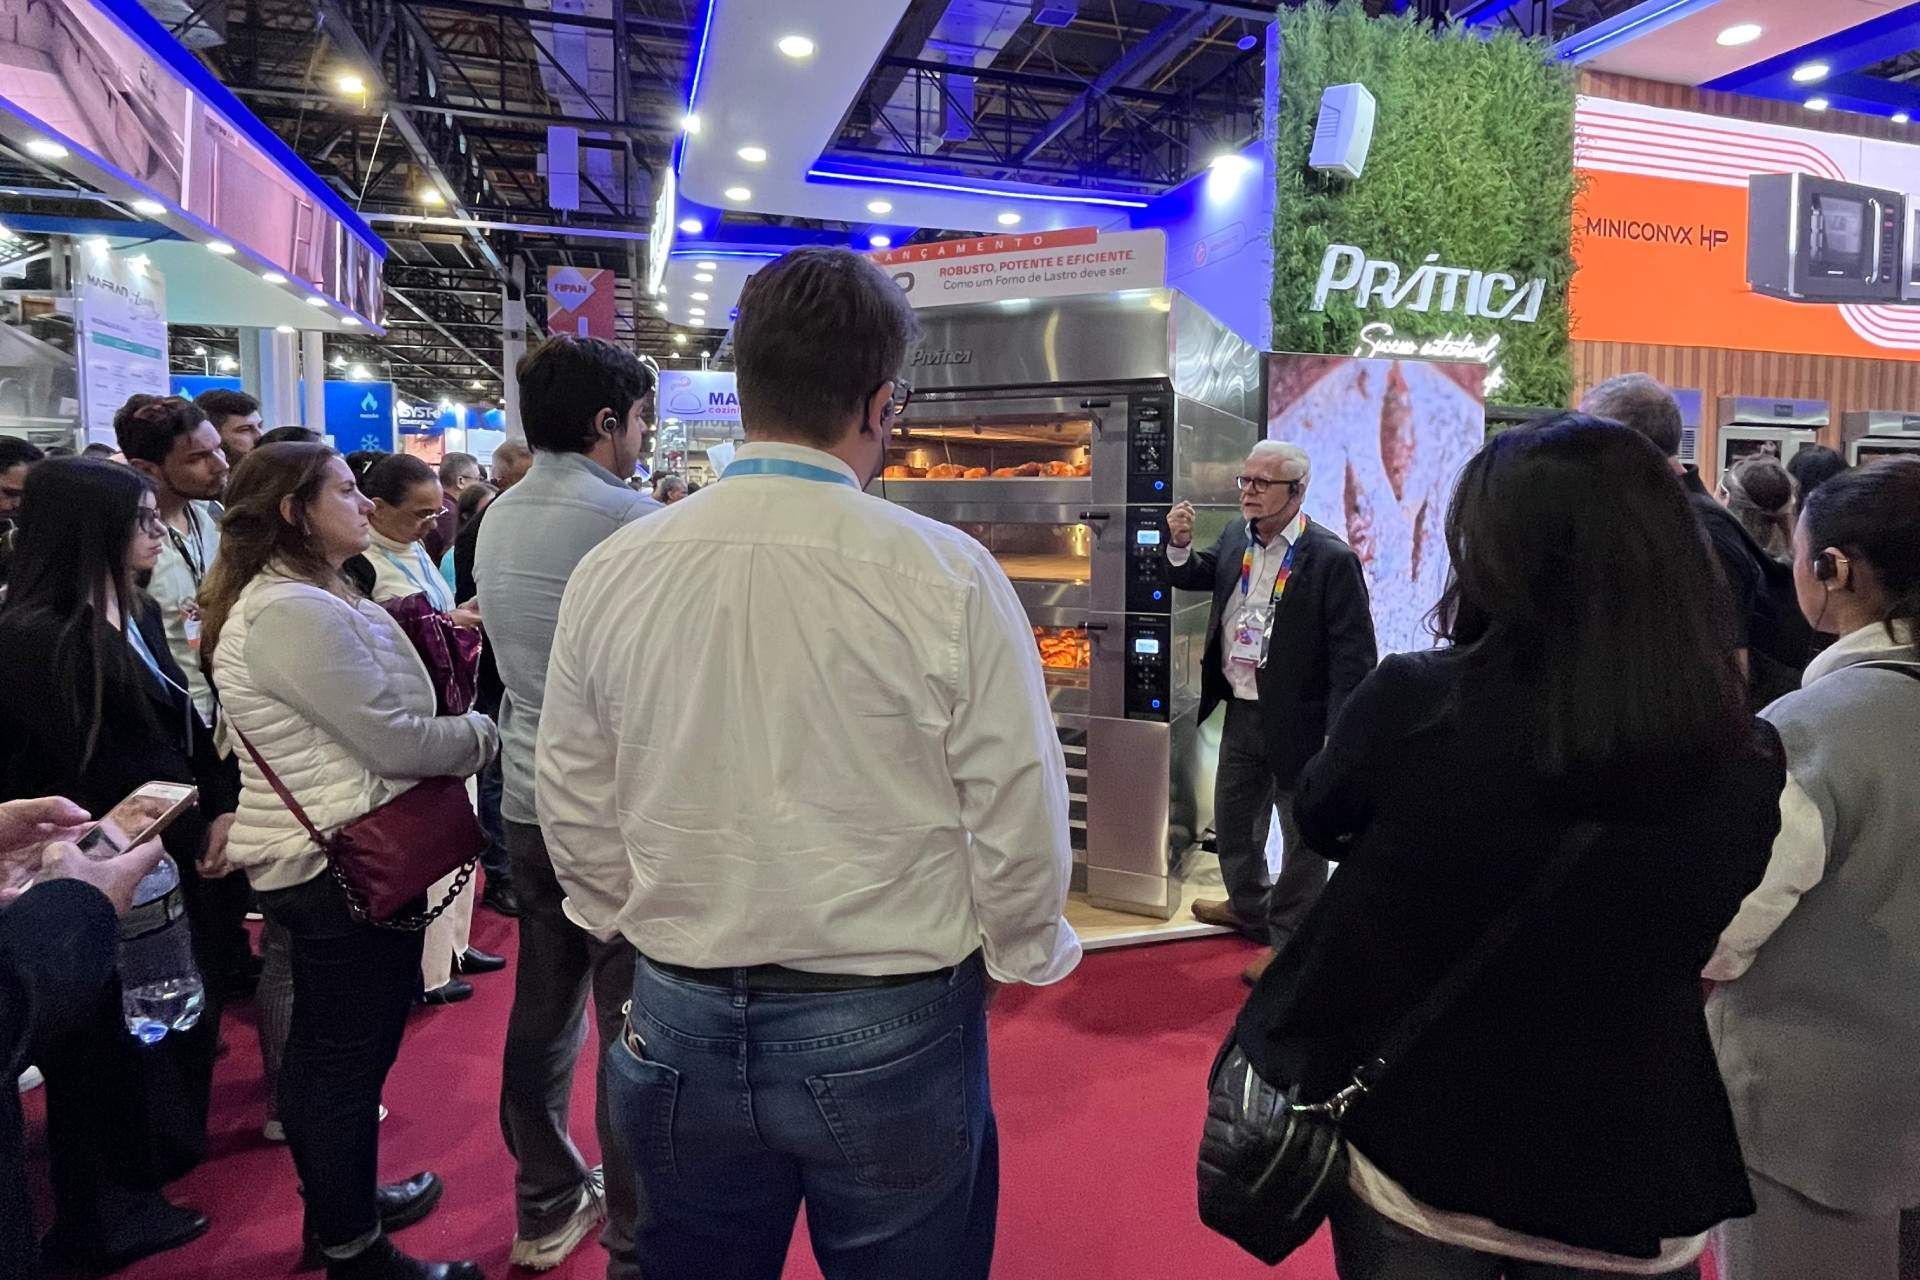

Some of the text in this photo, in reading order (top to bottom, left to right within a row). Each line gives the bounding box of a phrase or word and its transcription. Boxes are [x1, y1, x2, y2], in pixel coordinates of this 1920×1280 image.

[1586, 217, 1729, 252] MINICONVX HP
[939, 262, 996, 278] ROBUSTO,
[999, 257, 1053, 272] POTENTE
[1056, 257, 1064, 267] E
[943, 279, 974, 291] Como
[977, 279, 993, 287] um
[995, 274, 1026, 287] Forno
[1027, 271, 1042, 282] de
[1044, 268, 1078, 282] Lastro
[1080, 265, 1106, 277] deve
[1309, 244, 1546, 323] PRÁTICA
